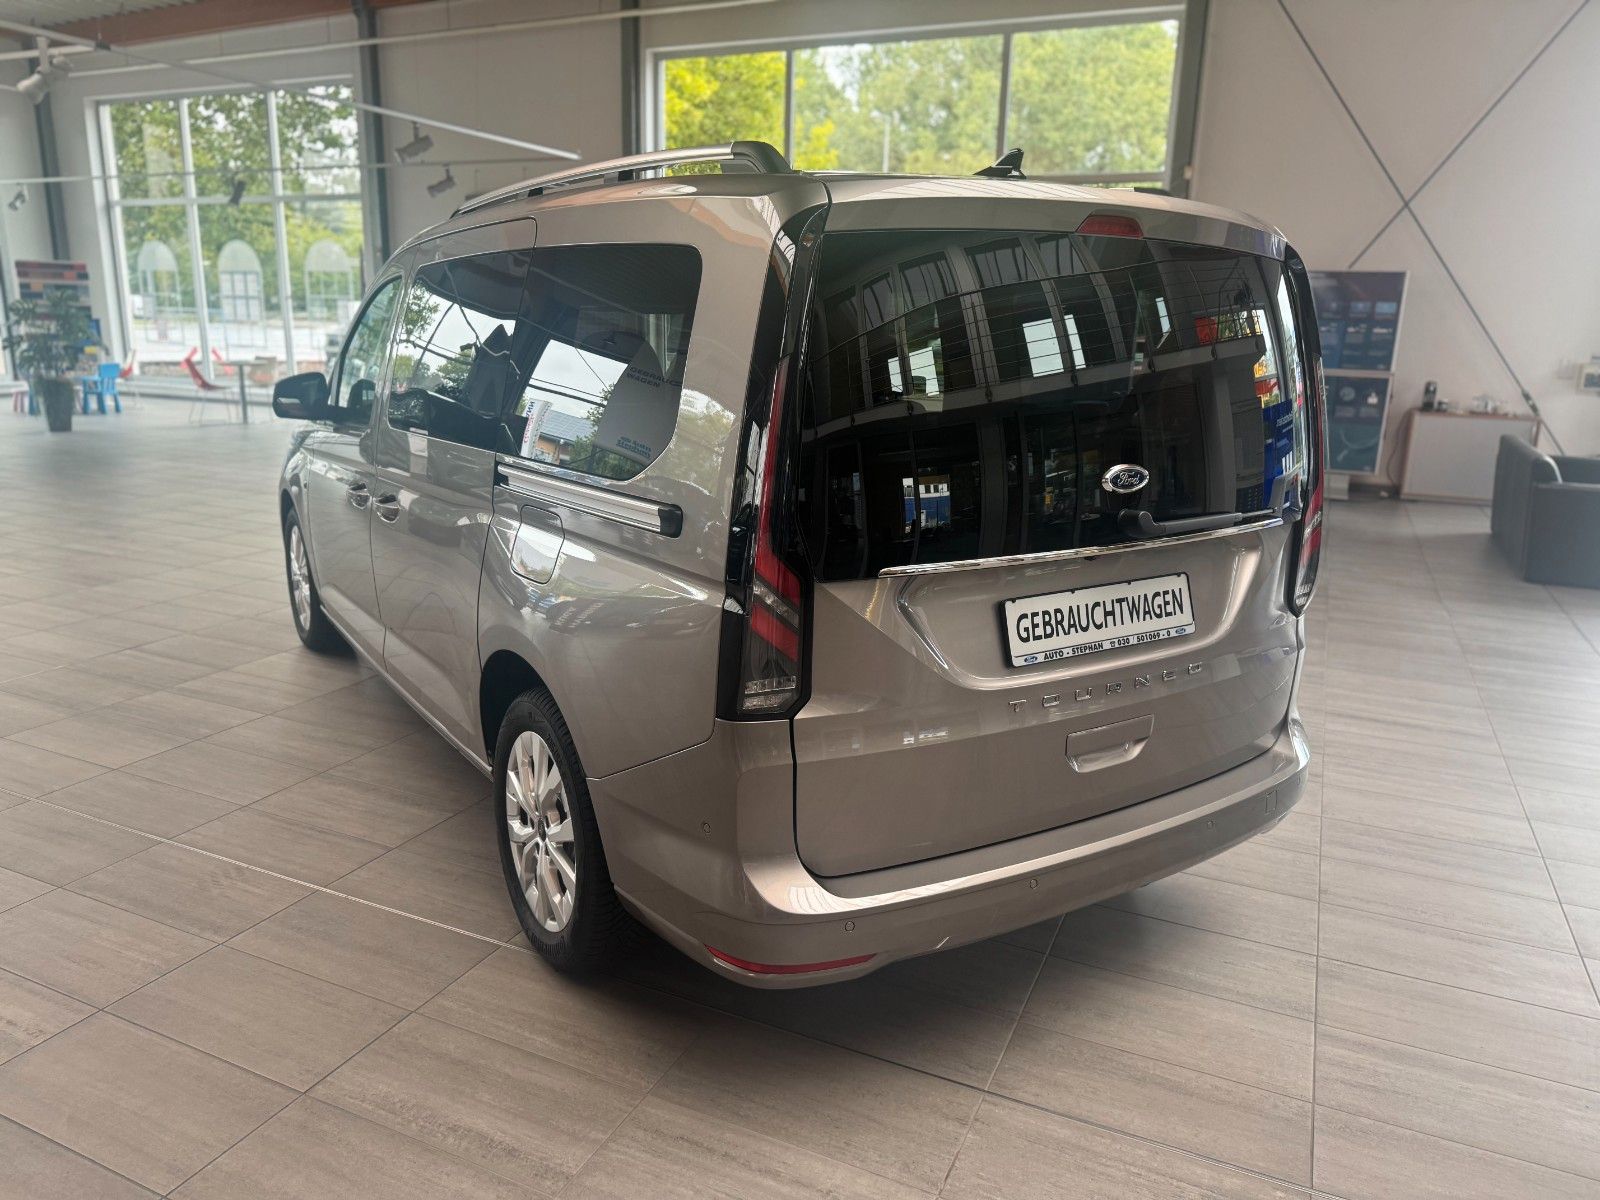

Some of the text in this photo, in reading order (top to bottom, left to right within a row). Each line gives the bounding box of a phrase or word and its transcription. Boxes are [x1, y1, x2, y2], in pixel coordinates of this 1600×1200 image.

[1016, 588, 1184, 643] GEBRAUCHTWAGEN
[1043, 650, 1064, 661] AUTO
[1071, 642, 1104, 655] STEPHAN
[1117, 637, 1130, 646] 030
[1136, 632, 1160, 643] 501069
[1009, 662, 1203, 712] TOURNEO
